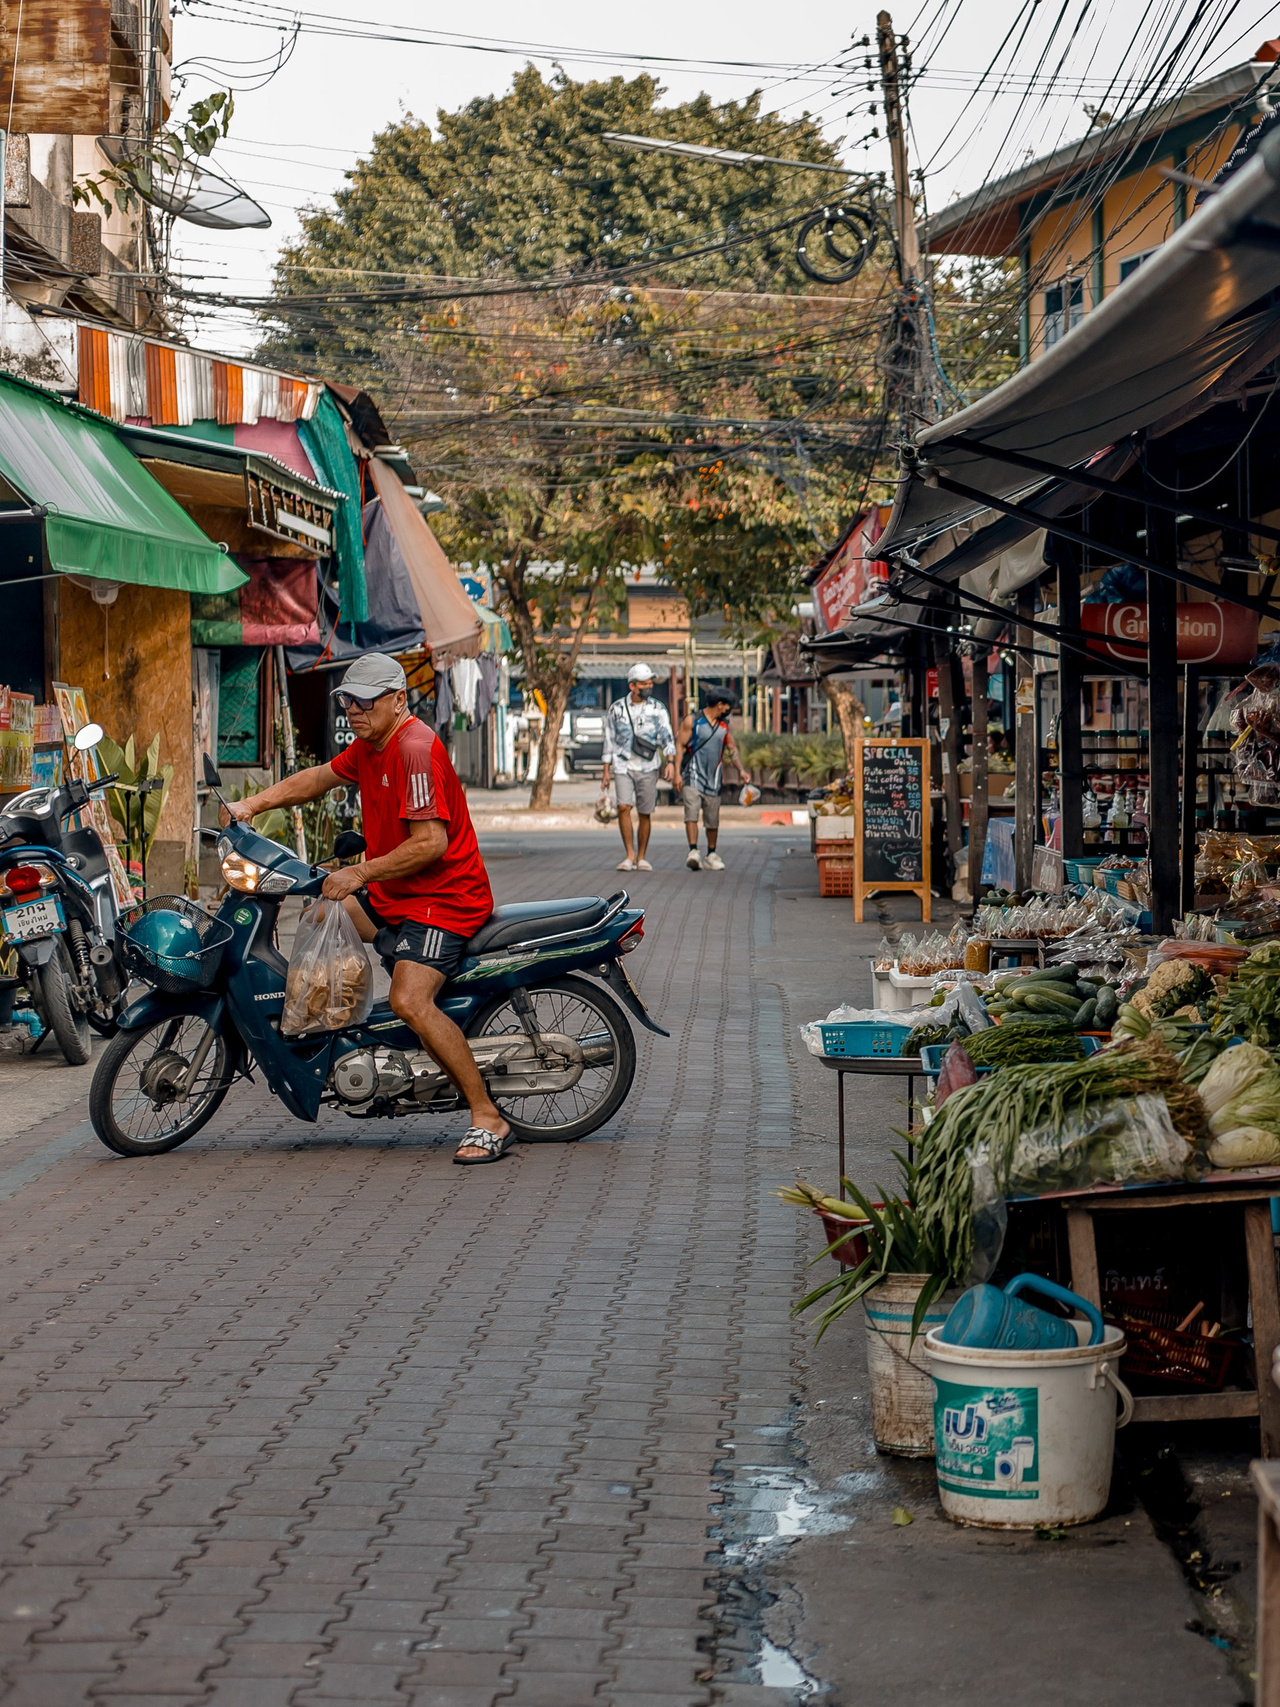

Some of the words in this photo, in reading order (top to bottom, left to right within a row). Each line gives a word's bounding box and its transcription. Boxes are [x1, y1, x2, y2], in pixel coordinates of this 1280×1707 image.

[863, 747, 913, 761] SPECIAL
[907, 767, 919, 775] 35
[880, 775, 904, 783] coffee
[906, 783, 919, 791] 40
[893, 800, 906, 809] 25
[909, 800, 921, 809] 35
[253, 991, 286, 1001] HOND
[945, 1406, 985, 1440] เปา
